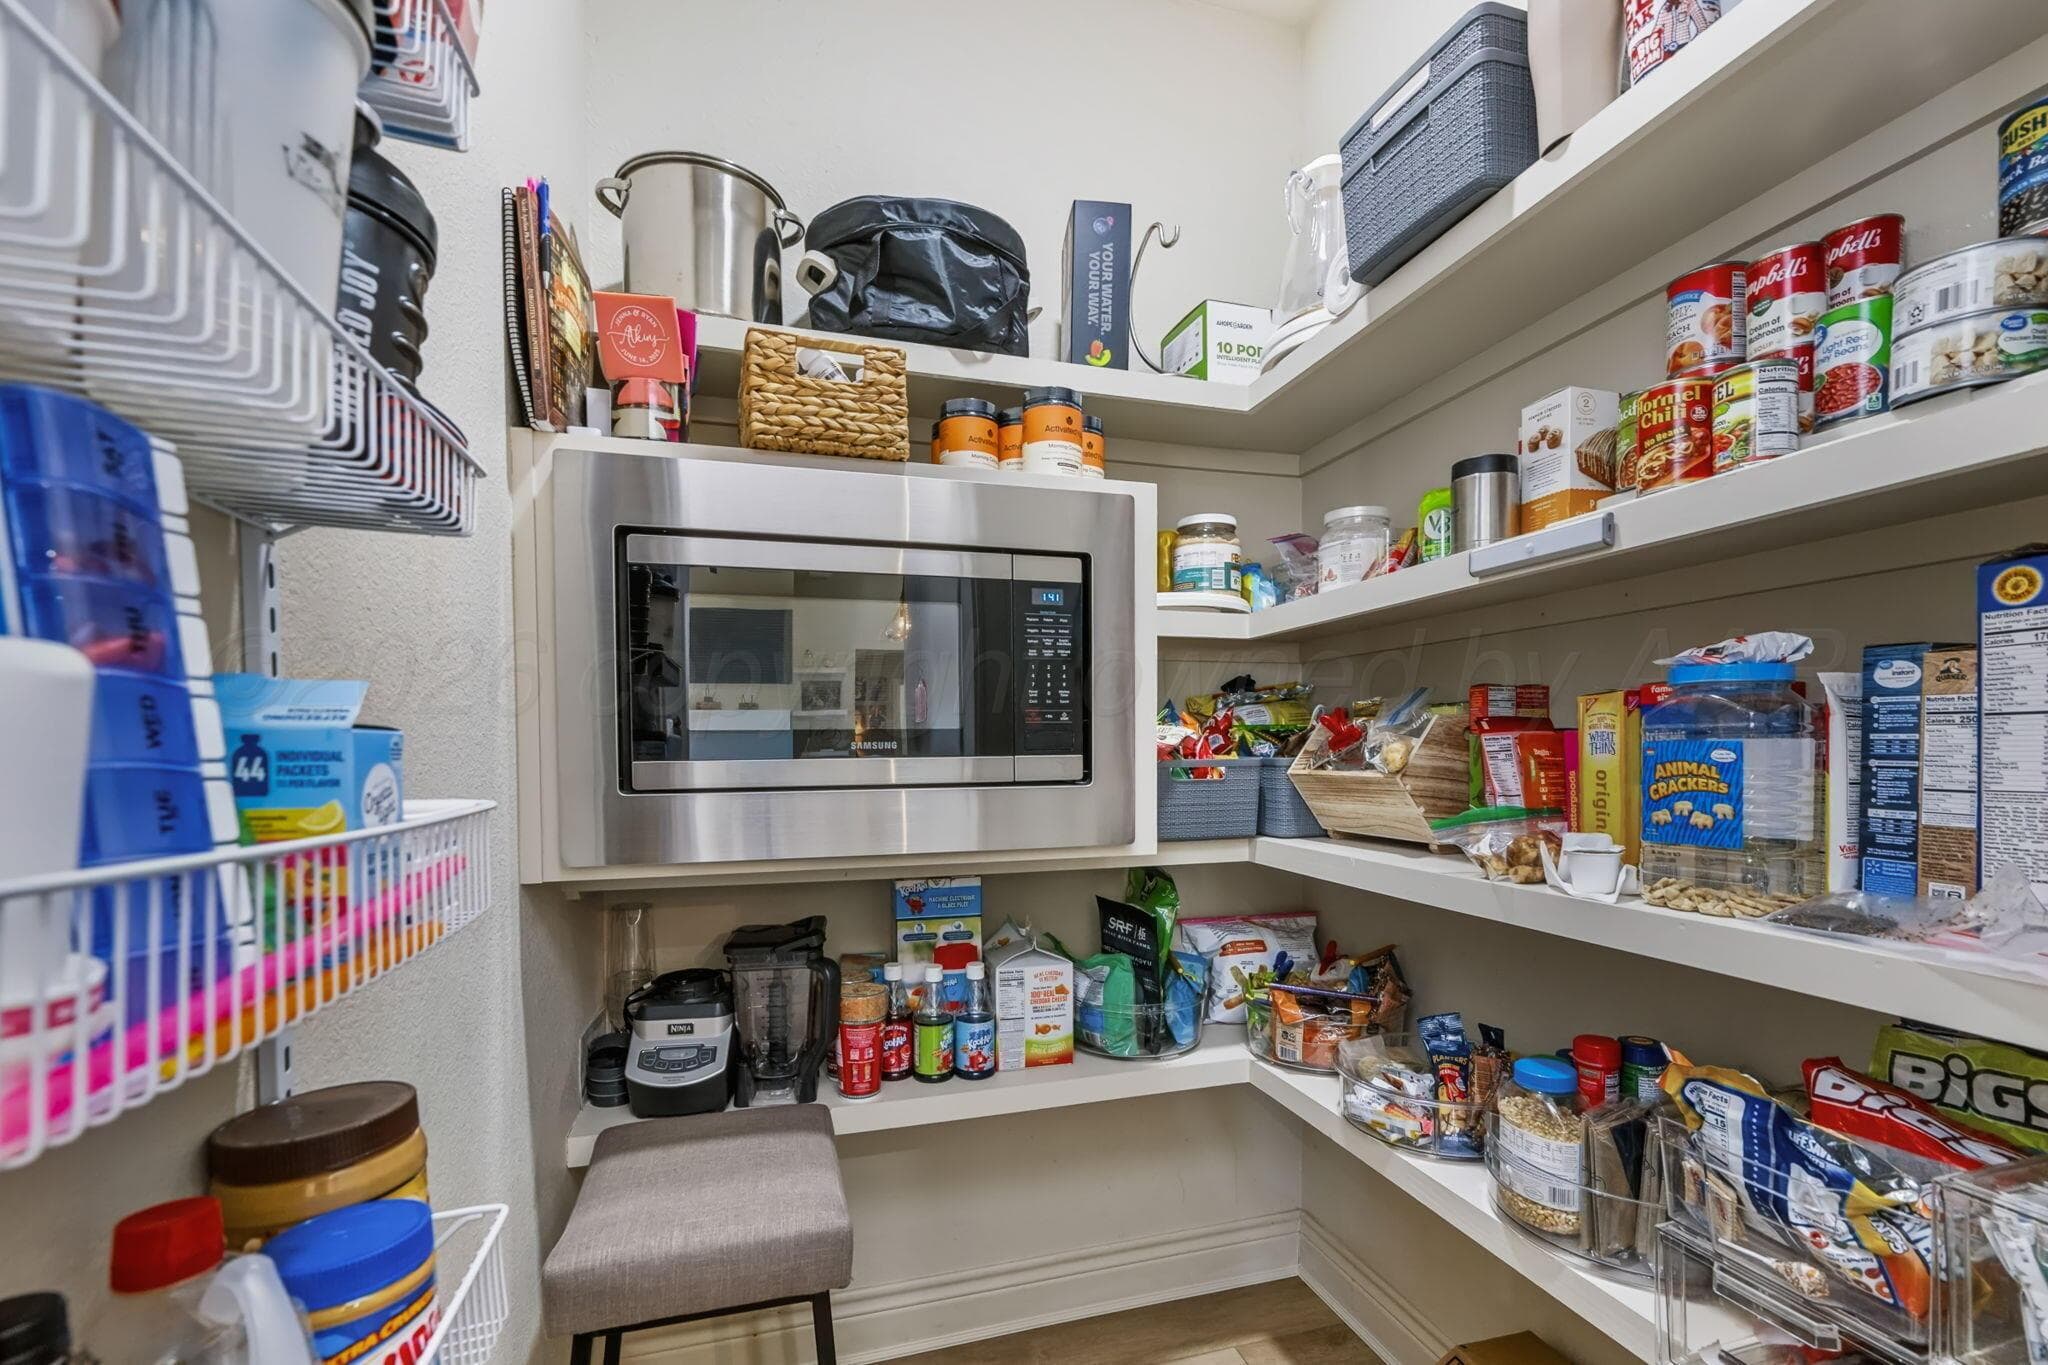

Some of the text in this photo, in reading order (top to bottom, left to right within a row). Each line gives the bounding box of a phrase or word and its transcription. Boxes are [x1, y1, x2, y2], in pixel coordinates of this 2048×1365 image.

[2001, 111, 2048, 149] BUSH
[1829, 228, 1882, 263] pbell's
[341, 248, 380, 311] JOY
[1747, 256, 1808, 296] mpbell's
[1087, 251, 1100, 326] YOUR WAY.
[1100, 242, 1114, 336] YOUR WATER.
[1771, 316, 1781, 326] of
[1217, 341, 1233, 354] 10
[1641, 402, 1687, 429] Chili
[1644, 425, 1685, 448] No Beans
[1985, 610, 2024, 621] Nutrition
[1985, 638, 2015, 646] Calories
[1892, 669, 1915, 677] instant
[1935, 672, 1968, 682] QUAKER
[1651, 685, 1673, 694] fam
[1588, 730, 1616, 742] WHEAT
[850, 740, 898, 751] SAMSUNG
[1588, 741, 1617, 756] THINS
[234, 756, 266, 782] 44
[1655, 761, 1720, 780] ANIMAL
[1648, 778, 1729, 800] CRACKERS
[1592, 769, 1610, 830] origin
[1108, 916, 1134, 934] SRF
[670, 1024, 692, 1034] NINJA
[1432, 1054, 1468, 1066] PLANTERS
[1714, 1117, 1726, 1129] 15
[1788, 1130, 1841, 1166] LIFESAV
